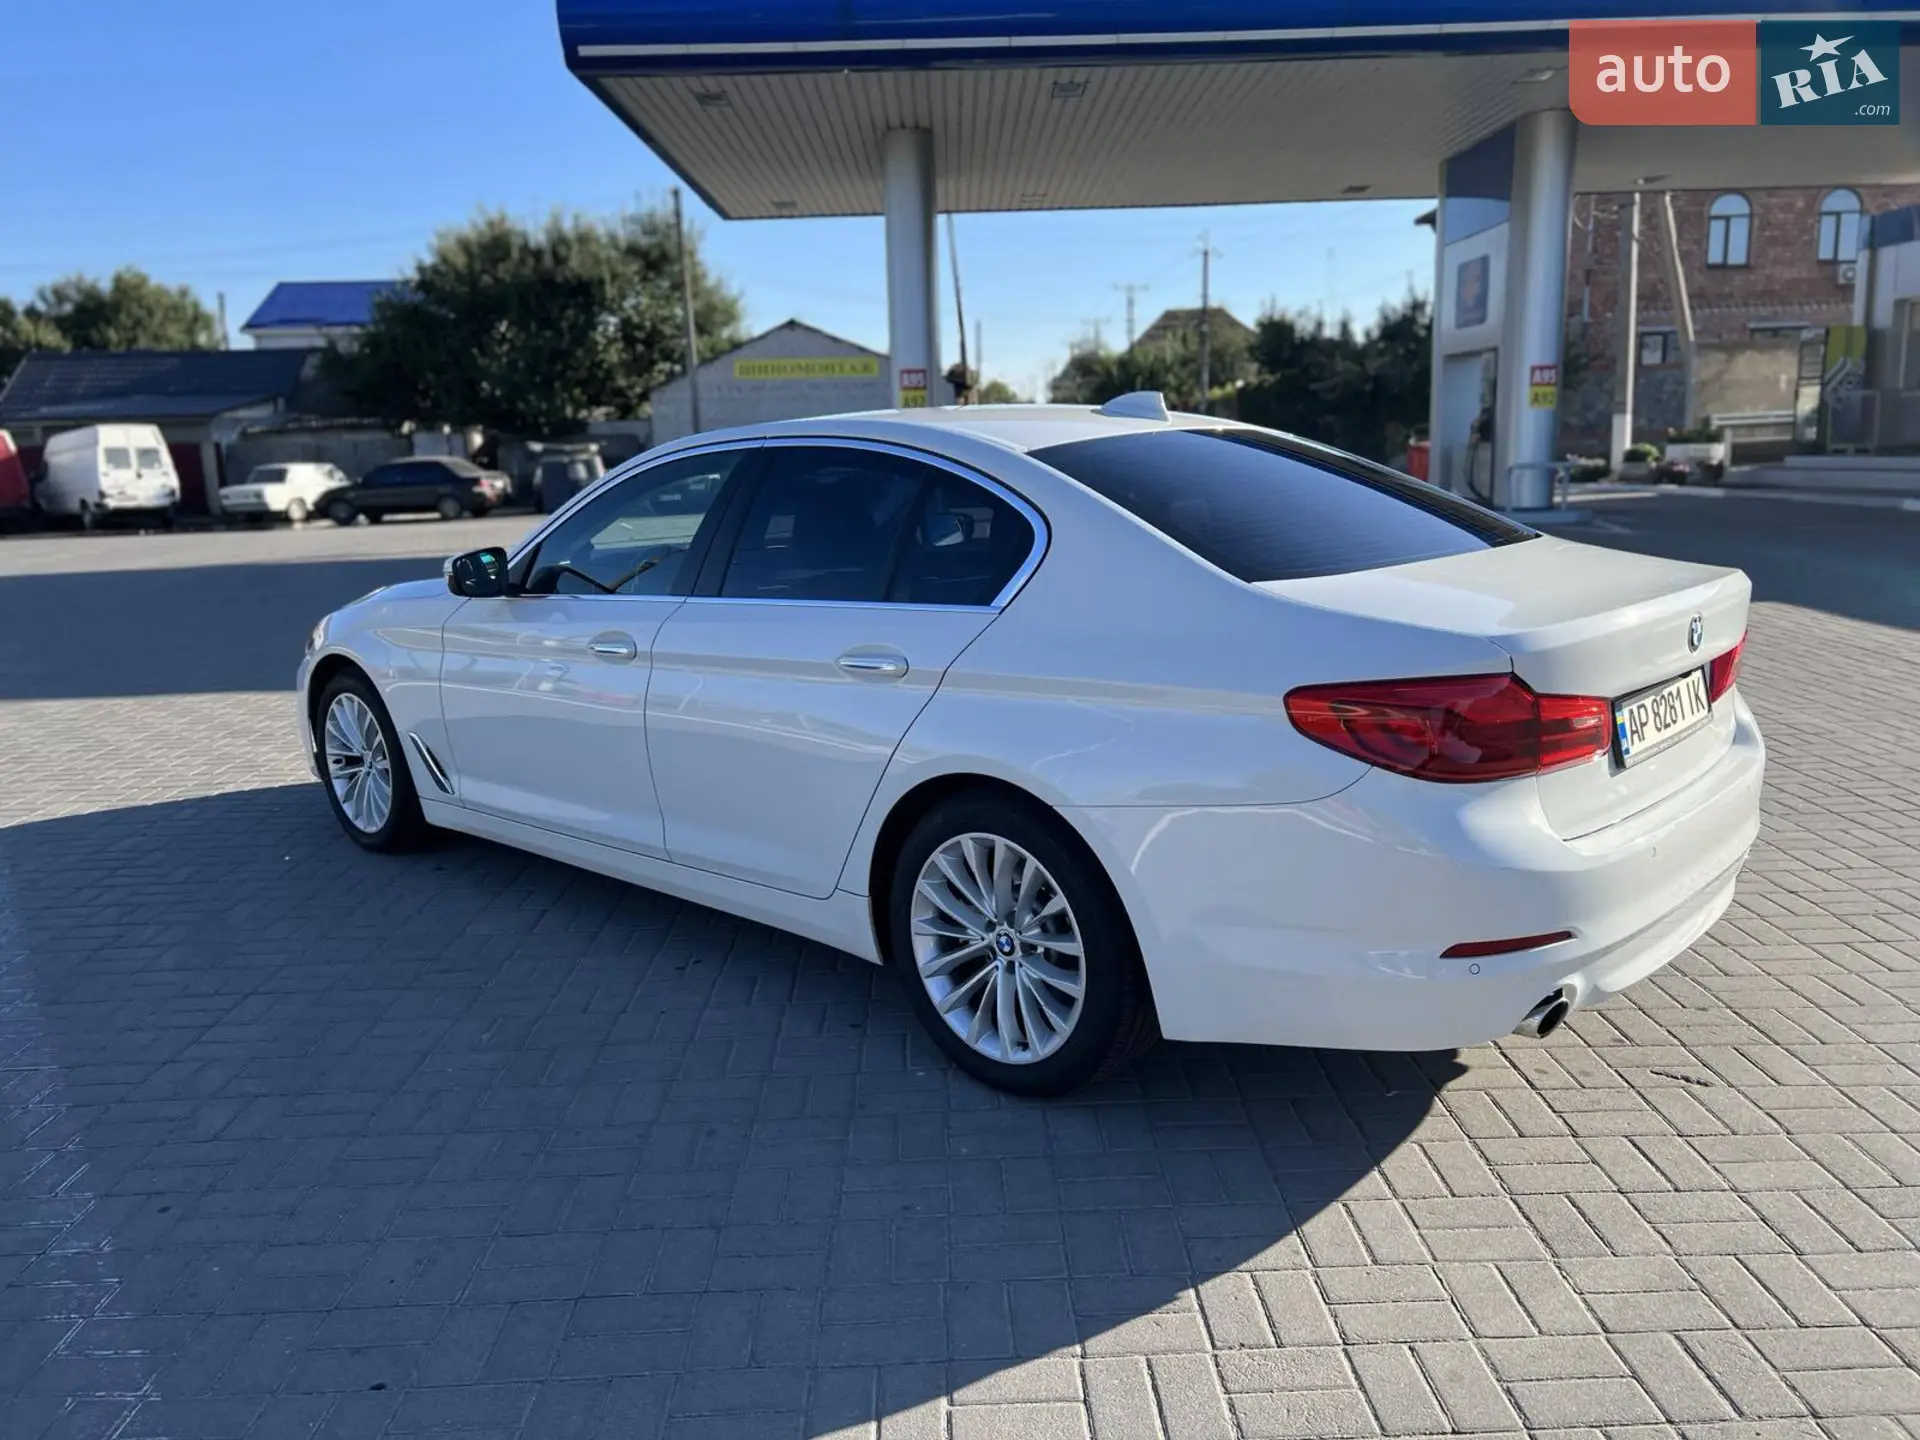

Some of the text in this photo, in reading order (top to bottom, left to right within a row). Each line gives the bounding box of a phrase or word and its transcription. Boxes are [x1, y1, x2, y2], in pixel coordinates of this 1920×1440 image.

[1628, 704, 1649, 746] AP
[1652, 687, 1686, 732] 8281
[1686, 677, 1706, 716] IK
